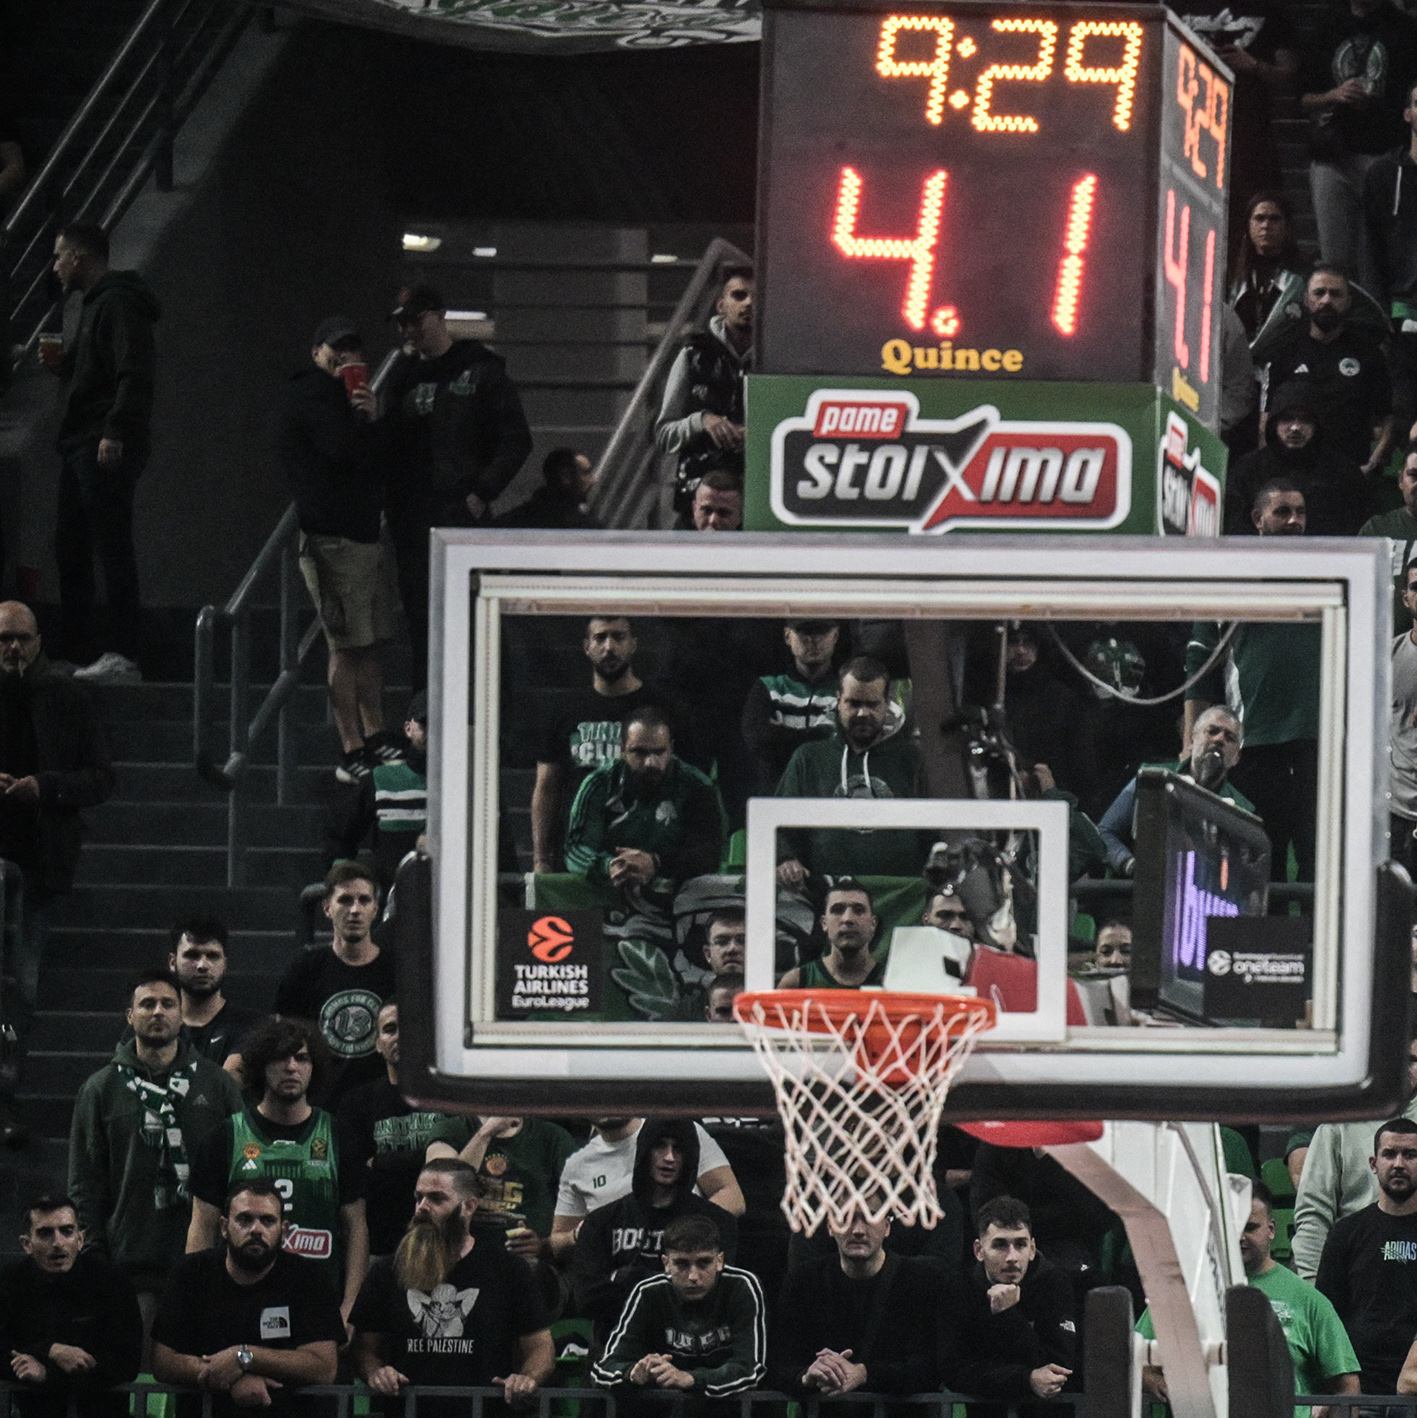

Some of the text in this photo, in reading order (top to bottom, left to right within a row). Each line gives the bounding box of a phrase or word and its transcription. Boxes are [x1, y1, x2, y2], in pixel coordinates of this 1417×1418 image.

[877, 14, 1144, 134] 9:29
[881, 338, 1024, 375] Quince
[821, 405, 898, 435] pame
[513, 964, 589, 981] TURKISH
[513, 980, 590, 996] AIRLINES
[511, 995, 591, 1012] EuroLeague
[593, 1174, 606, 1189] 10
[1383, 1240, 1417, 1262] ADIDAS
[426, 1338, 475, 1355] PALESTINE
